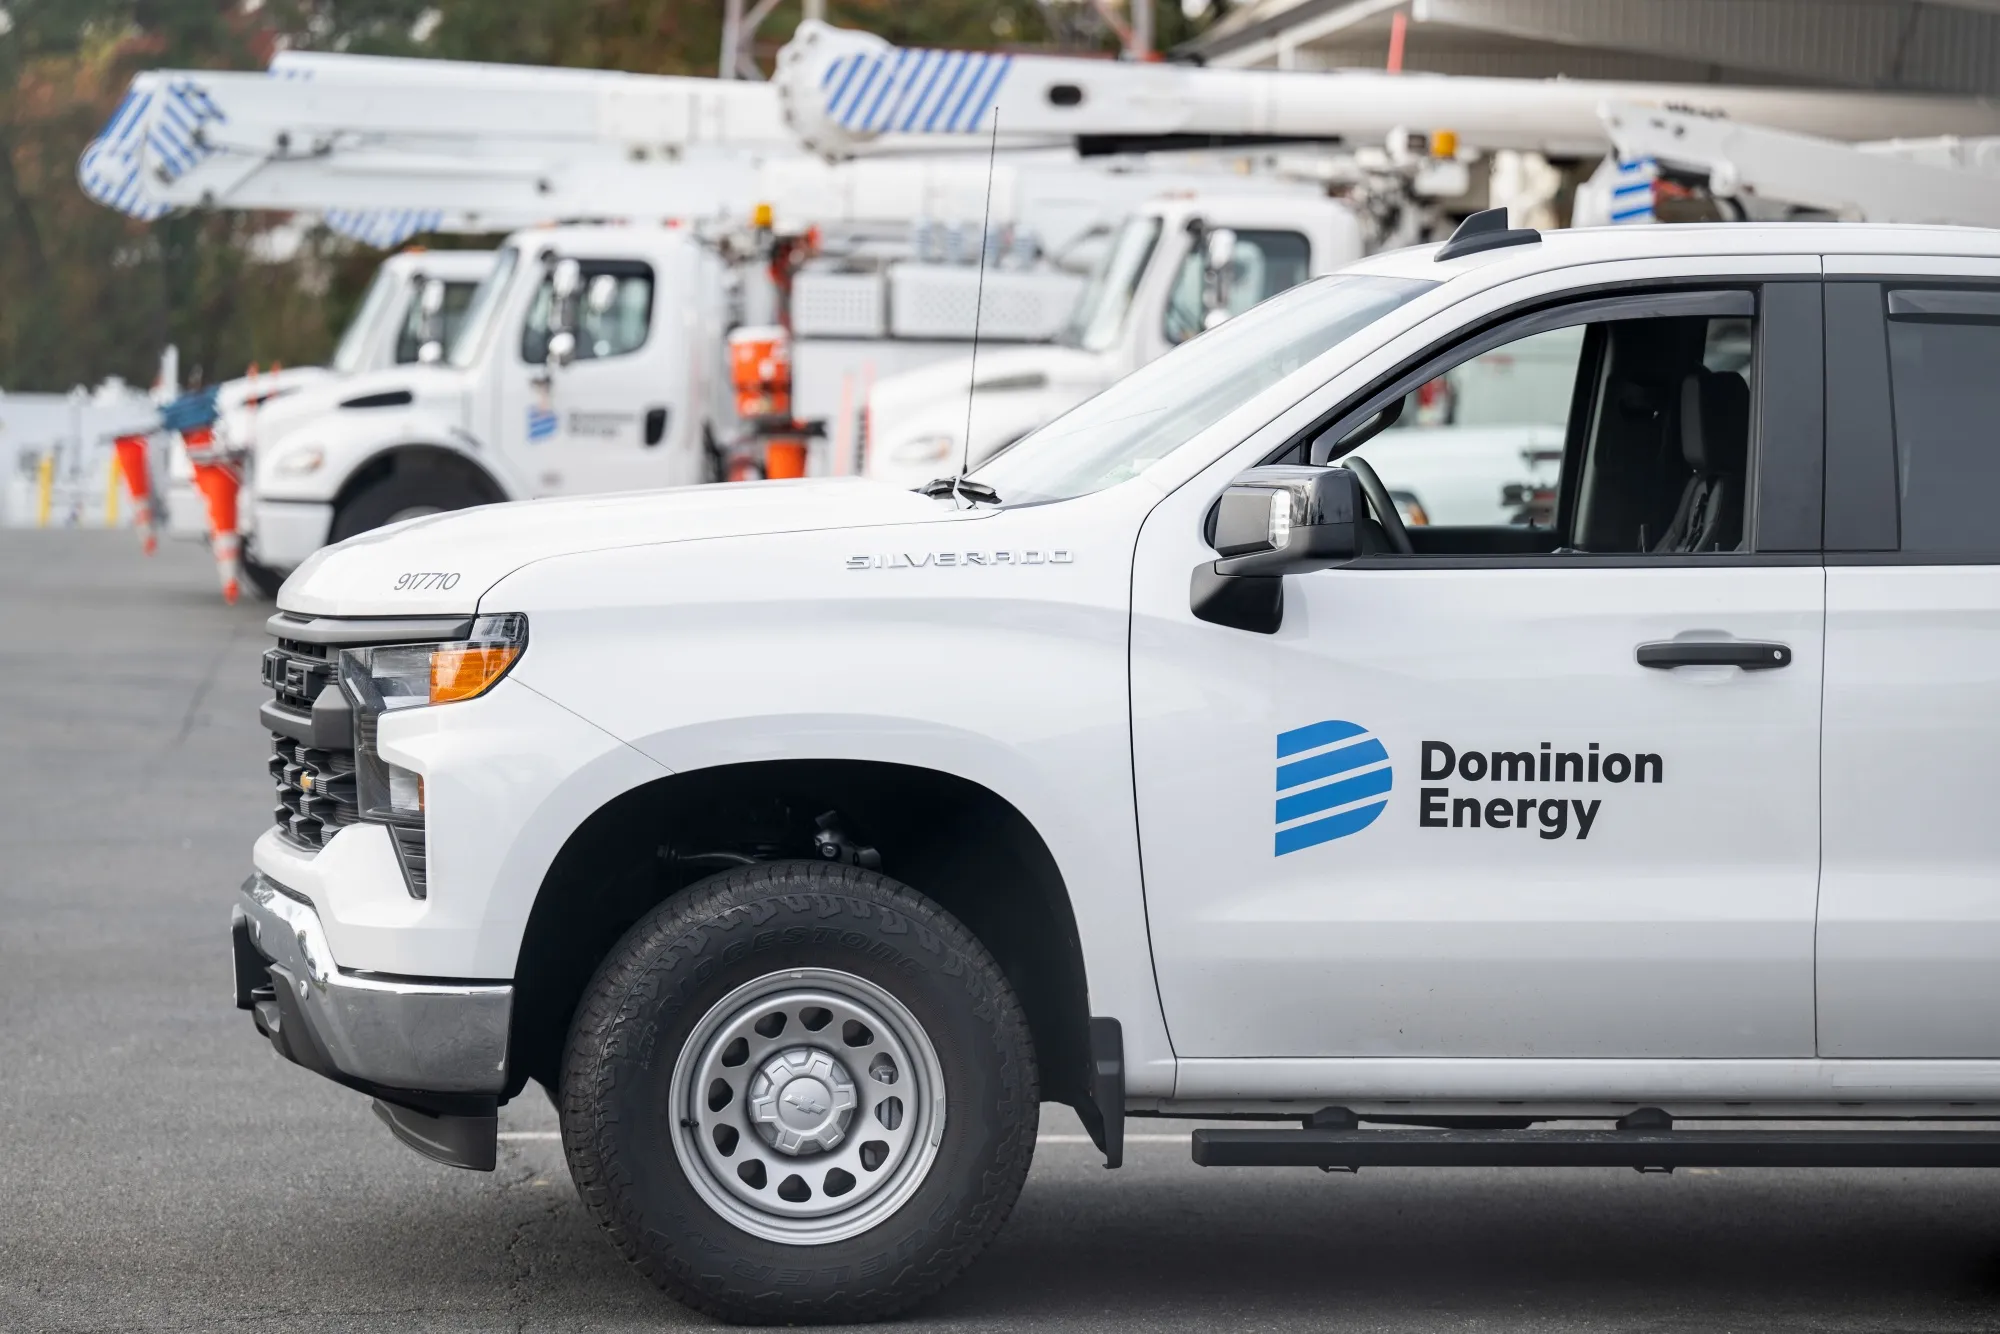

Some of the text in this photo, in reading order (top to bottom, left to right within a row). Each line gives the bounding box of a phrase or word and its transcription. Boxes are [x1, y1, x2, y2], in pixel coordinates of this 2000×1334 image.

[393, 572, 462, 591] 917710
[845, 550, 1074, 570] SILVERADO
[1420, 740, 1664, 784] Dominion
[1419, 787, 1602, 840] Energy
[731, 1194, 957, 1287] DUELER
